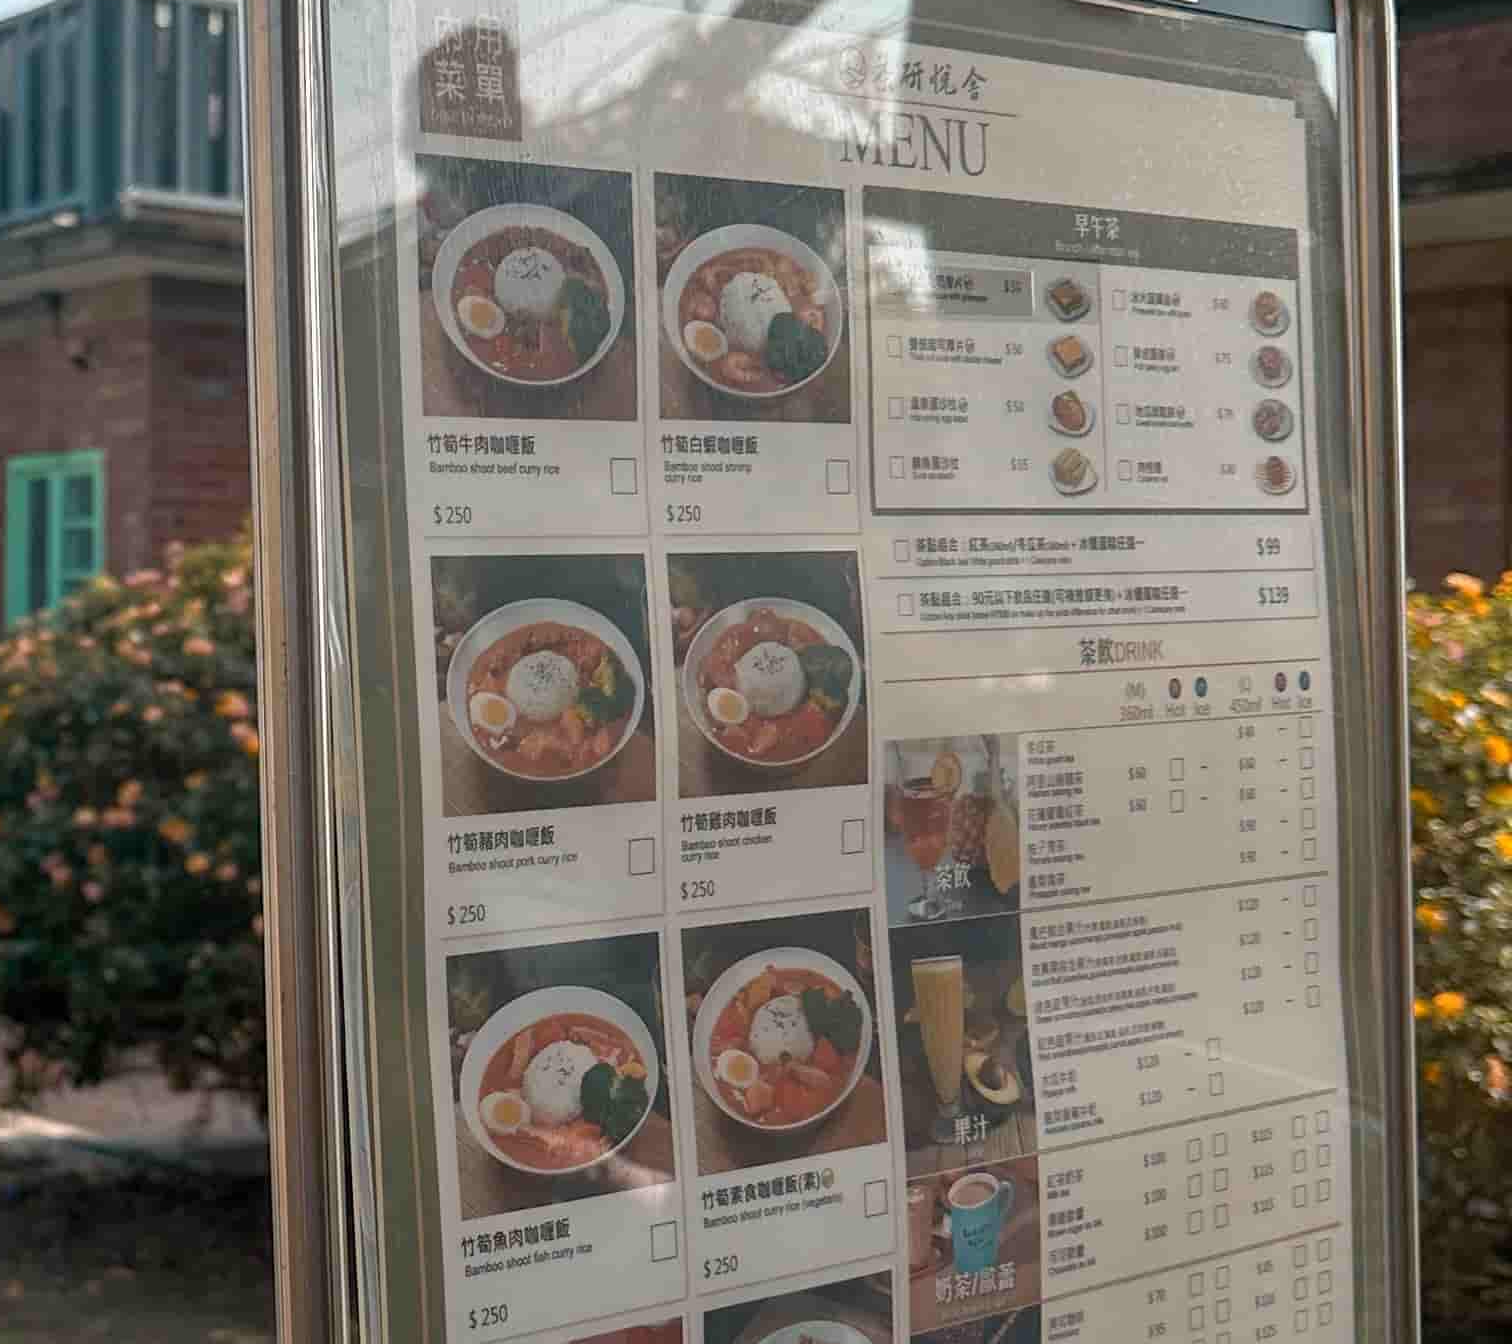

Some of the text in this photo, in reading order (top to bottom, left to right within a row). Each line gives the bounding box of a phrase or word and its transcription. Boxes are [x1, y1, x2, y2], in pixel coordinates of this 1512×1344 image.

[839, 111, 990, 176] MENU
[429, 460, 468, 474] Bamboo
[544, 463, 560, 475] rice
[449, 859, 486, 874] Bamboo
[516, 855, 535, 869] pork
[538, 854, 559, 867] curry
[562, 852, 578, 862] rice
[954, 1112, 991, 1145] 果汁
[704, 1214, 738, 1229] Bamboo
[464, 1261, 504, 1278] Bamboo
[534, 1250, 550, 1264] fish
[552, 1246, 574, 1260] curry
